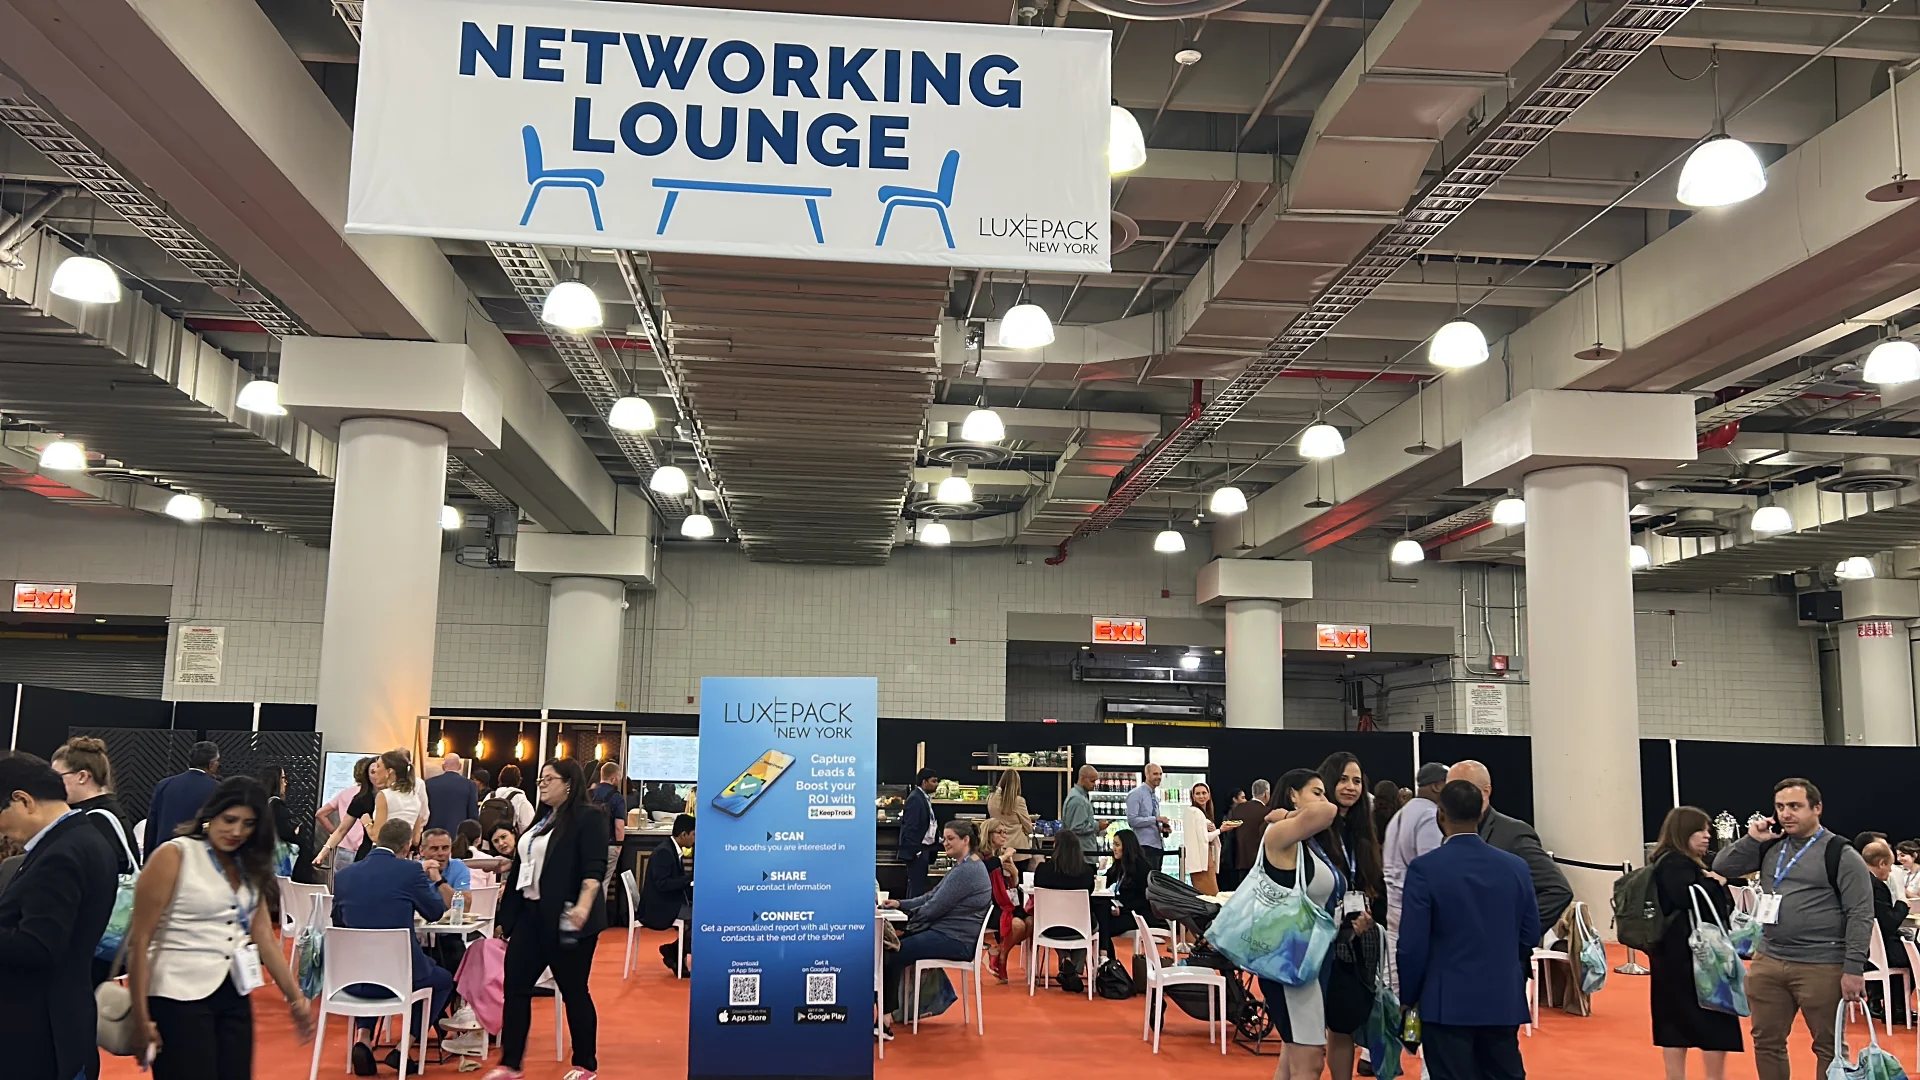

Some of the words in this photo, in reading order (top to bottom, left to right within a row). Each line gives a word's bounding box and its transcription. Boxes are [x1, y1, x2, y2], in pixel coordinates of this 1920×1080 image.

[458, 21, 1022, 109] NETWORKING
[571, 96, 910, 171] LOUNGE
[1029, 242, 1060, 253] NEW
[1063, 243, 1098, 254] YORK
[16, 588, 73, 609] Exit
[1094, 620, 1145, 642] Exit
[1319, 628, 1368, 649] Exit
[777, 727, 811, 739] NEW
[815, 727, 852, 739] YORK
[811, 753, 856, 766] Capture
[811, 767, 845, 777] Leads
[847, 767, 855, 777] &
[796, 780, 829, 791] Boost
[830, 782, 856, 793] your
[808, 794, 829, 804] ROI
[830, 793, 856, 804] with
[819, 809, 853, 817] KeepTrack
[774, 831, 804, 841] SCAN
[725, 843, 737, 851] the
[739, 843, 766, 851] booths
[798, 843, 837, 851] interested
[770, 871, 807, 881] SHARE
[737, 884, 755, 892] your
[756, 883, 785, 891] contact
[787, 882, 831, 891] information
[760, 911, 815, 921] CONNECT
[701, 924, 715, 932] Get
[724, 924, 774, 933] personalized
[775, 923, 799, 932] report
[801, 923, 817, 931] with
[819, 923, 829, 931] all
[830, 924, 847, 932] your
[721, 934, 755, 942] contacts
[780, 933, 796, 941] end
[822, 933, 845, 941] show!
[731, 1014, 747, 1023] App
[807, 1012, 830, 1021] Google
[831, 1012, 845, 1021] Play
